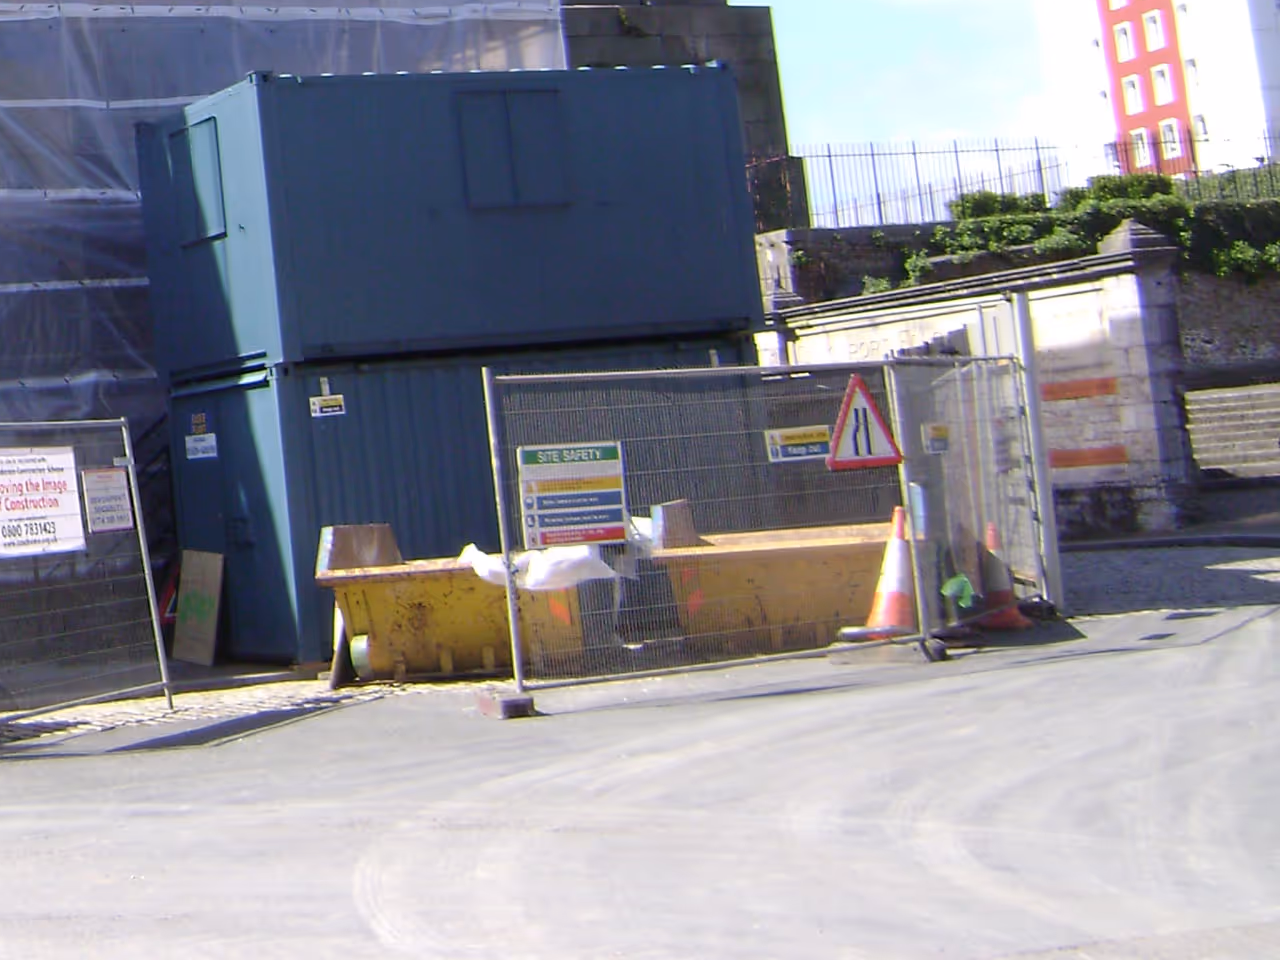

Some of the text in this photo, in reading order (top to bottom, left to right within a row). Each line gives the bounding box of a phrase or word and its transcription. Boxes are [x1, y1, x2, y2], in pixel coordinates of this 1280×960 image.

[537, 448, 601, 463] SITE SAFETY
[25, 479, 40, 492] the
[41, 478, 68, 494] Image
[4, 497, 59, 512] Construction
[1, 521, 57, 538] 0800 7831423
